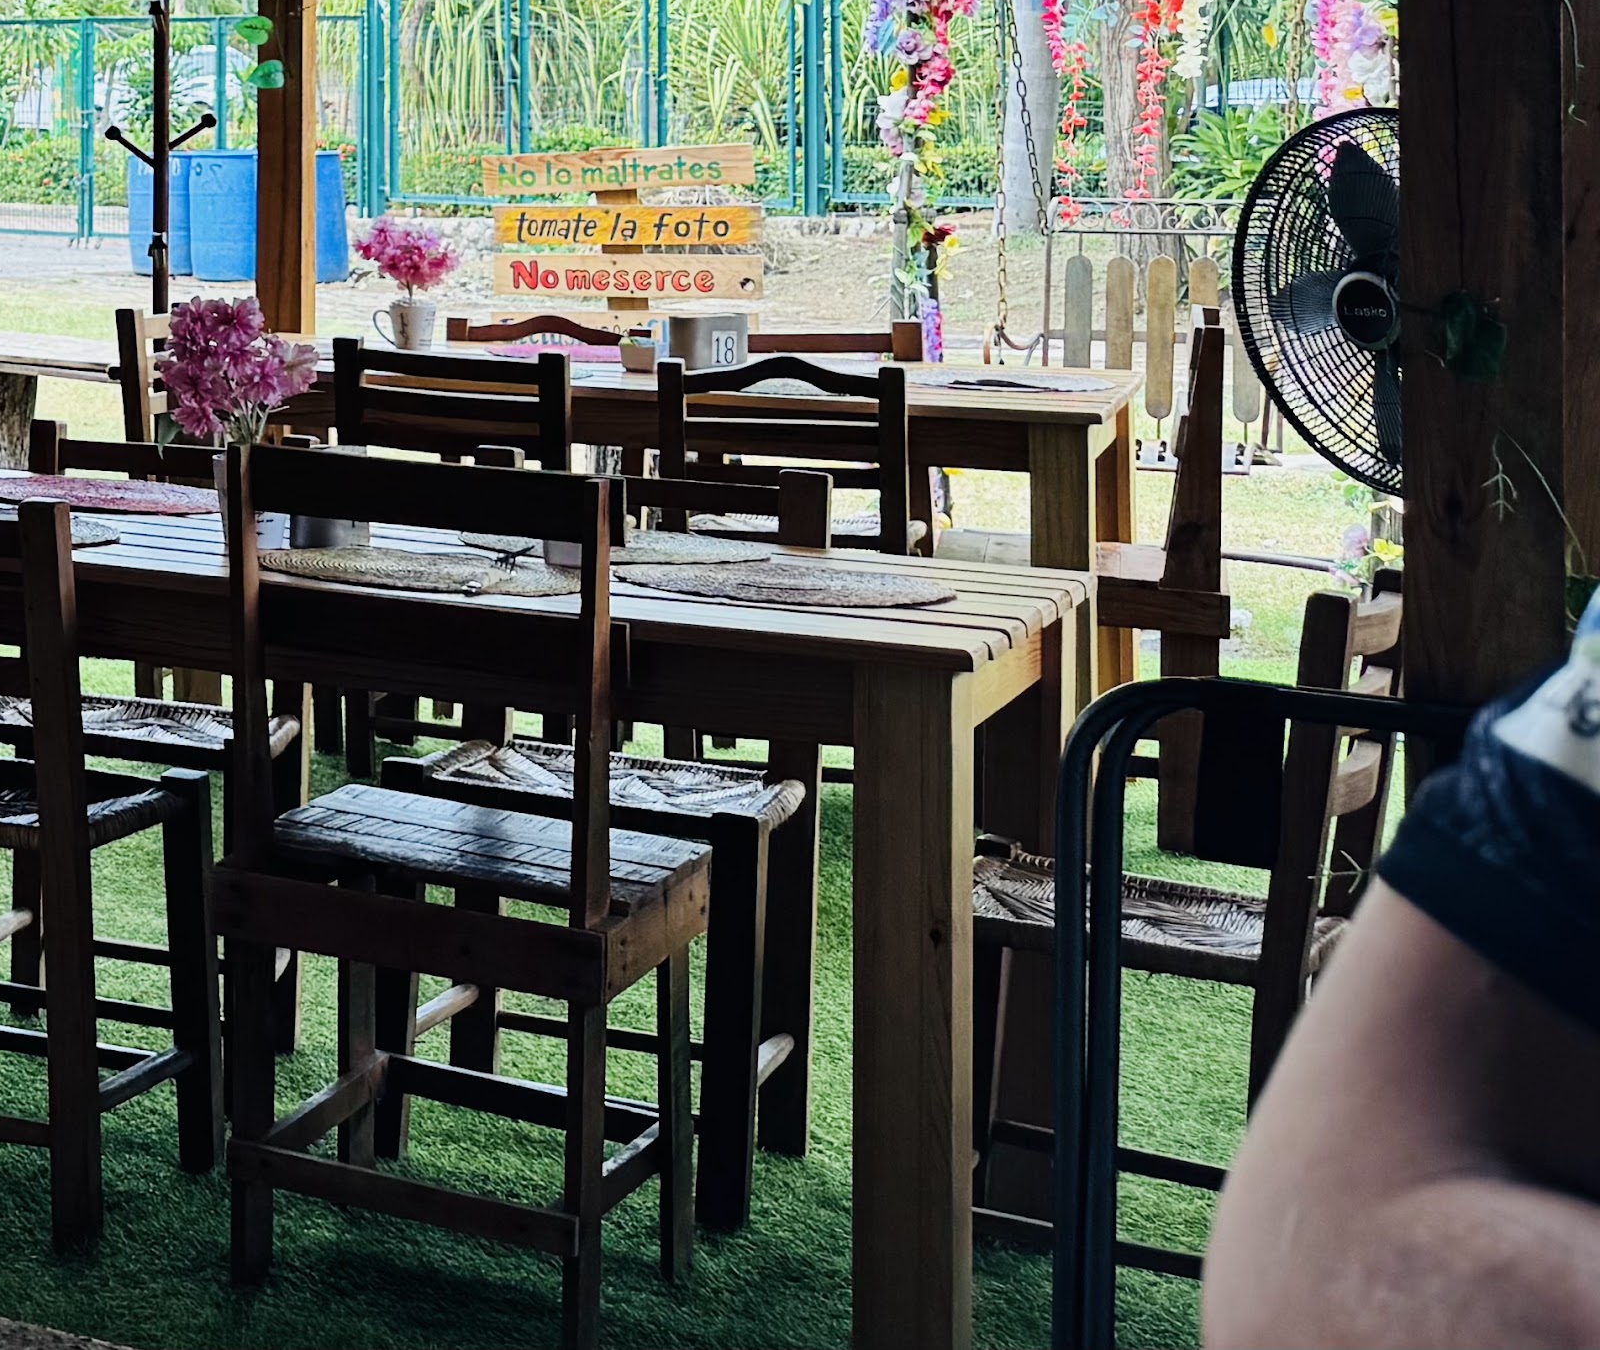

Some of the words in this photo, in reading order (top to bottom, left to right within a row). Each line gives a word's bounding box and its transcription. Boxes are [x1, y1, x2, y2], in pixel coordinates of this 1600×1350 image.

[498, 162, 537, 188] No
[545, 161, 573, 186] lo
[581, 156, 723, 185] maltrates
[515, 212, 598, 243] tomate
[609, 212, 638, 241] la
[653, 212, 730, 242] foto
[510, 260, 559, 291] No
[1343, 306, 1388, 318] Lasko
[714, 335, 735, 364] 18
